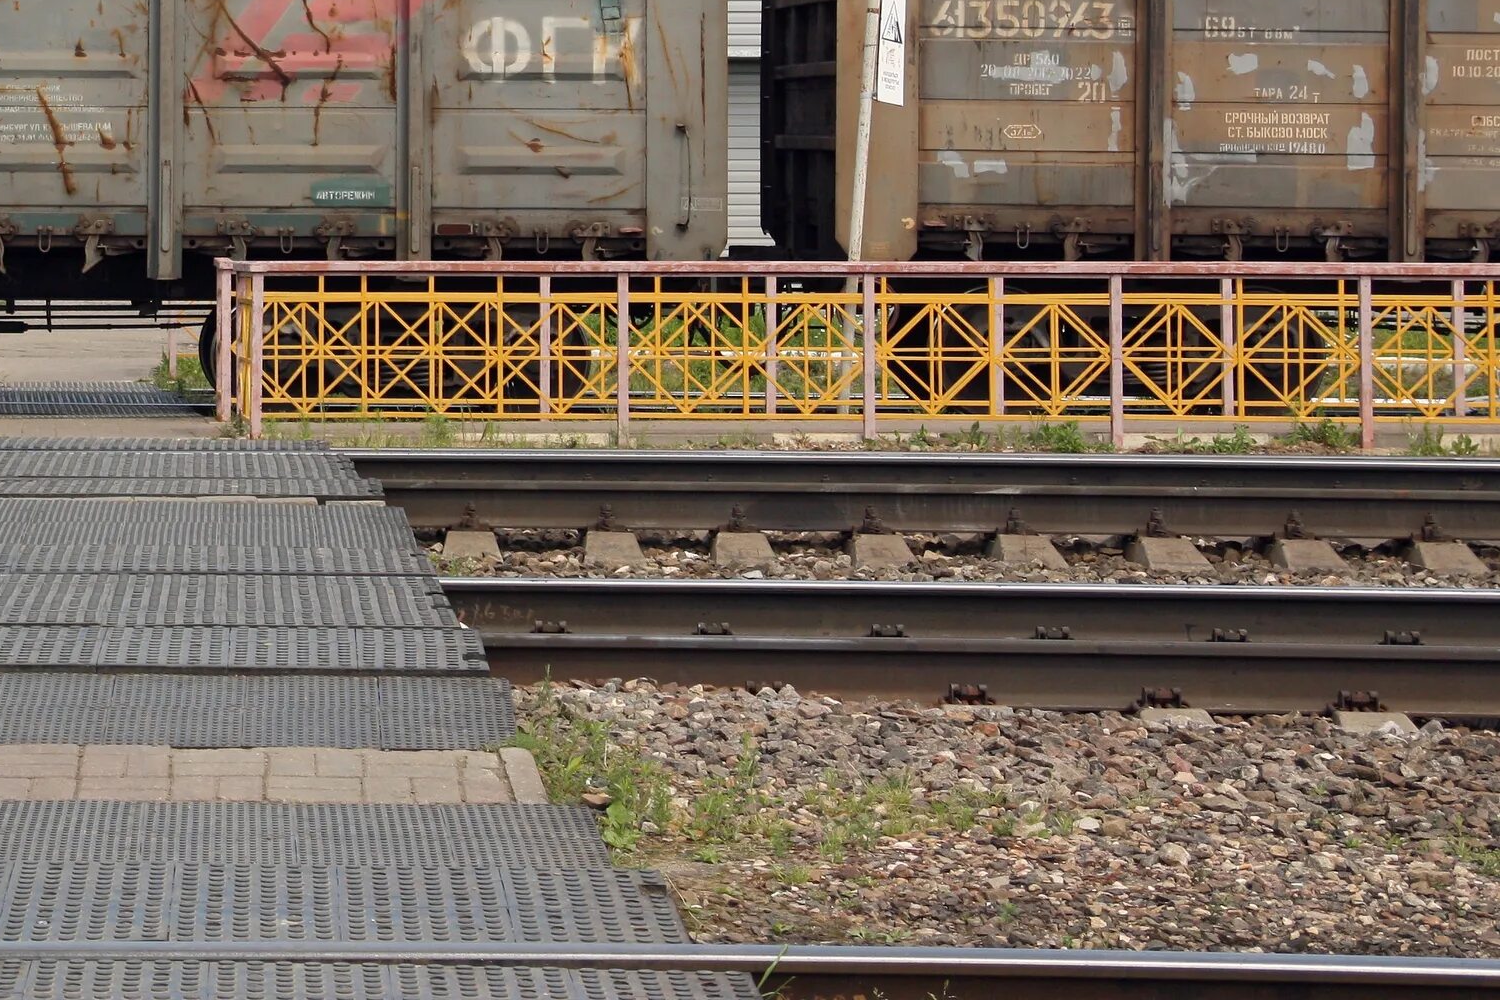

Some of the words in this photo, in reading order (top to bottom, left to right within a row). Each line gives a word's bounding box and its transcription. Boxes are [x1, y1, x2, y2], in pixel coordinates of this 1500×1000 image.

[930, 0, 1115, 39] 61350963
[462, 16, 644, 84] ФГК
[1466, 49, 1500, 61] ПОСТ
[1077, 81, 1106, 104] 20
[1253, 87, 1283, 100] ТАРА
[1288, 85, 1308, 100] 24
[1225, 109, 1280, 124] СРОЧНЫЙ
[1281, 113, 1331, 125] ВОЗВРАТ
[1227, 126, 1244, 138] СТ.
[1246, 126, 1293, 138] БЫКОВО
[1295, 127, 1328, 139] МОСК
[316, 190, 376, 201] АВТОРЕЖИМ
